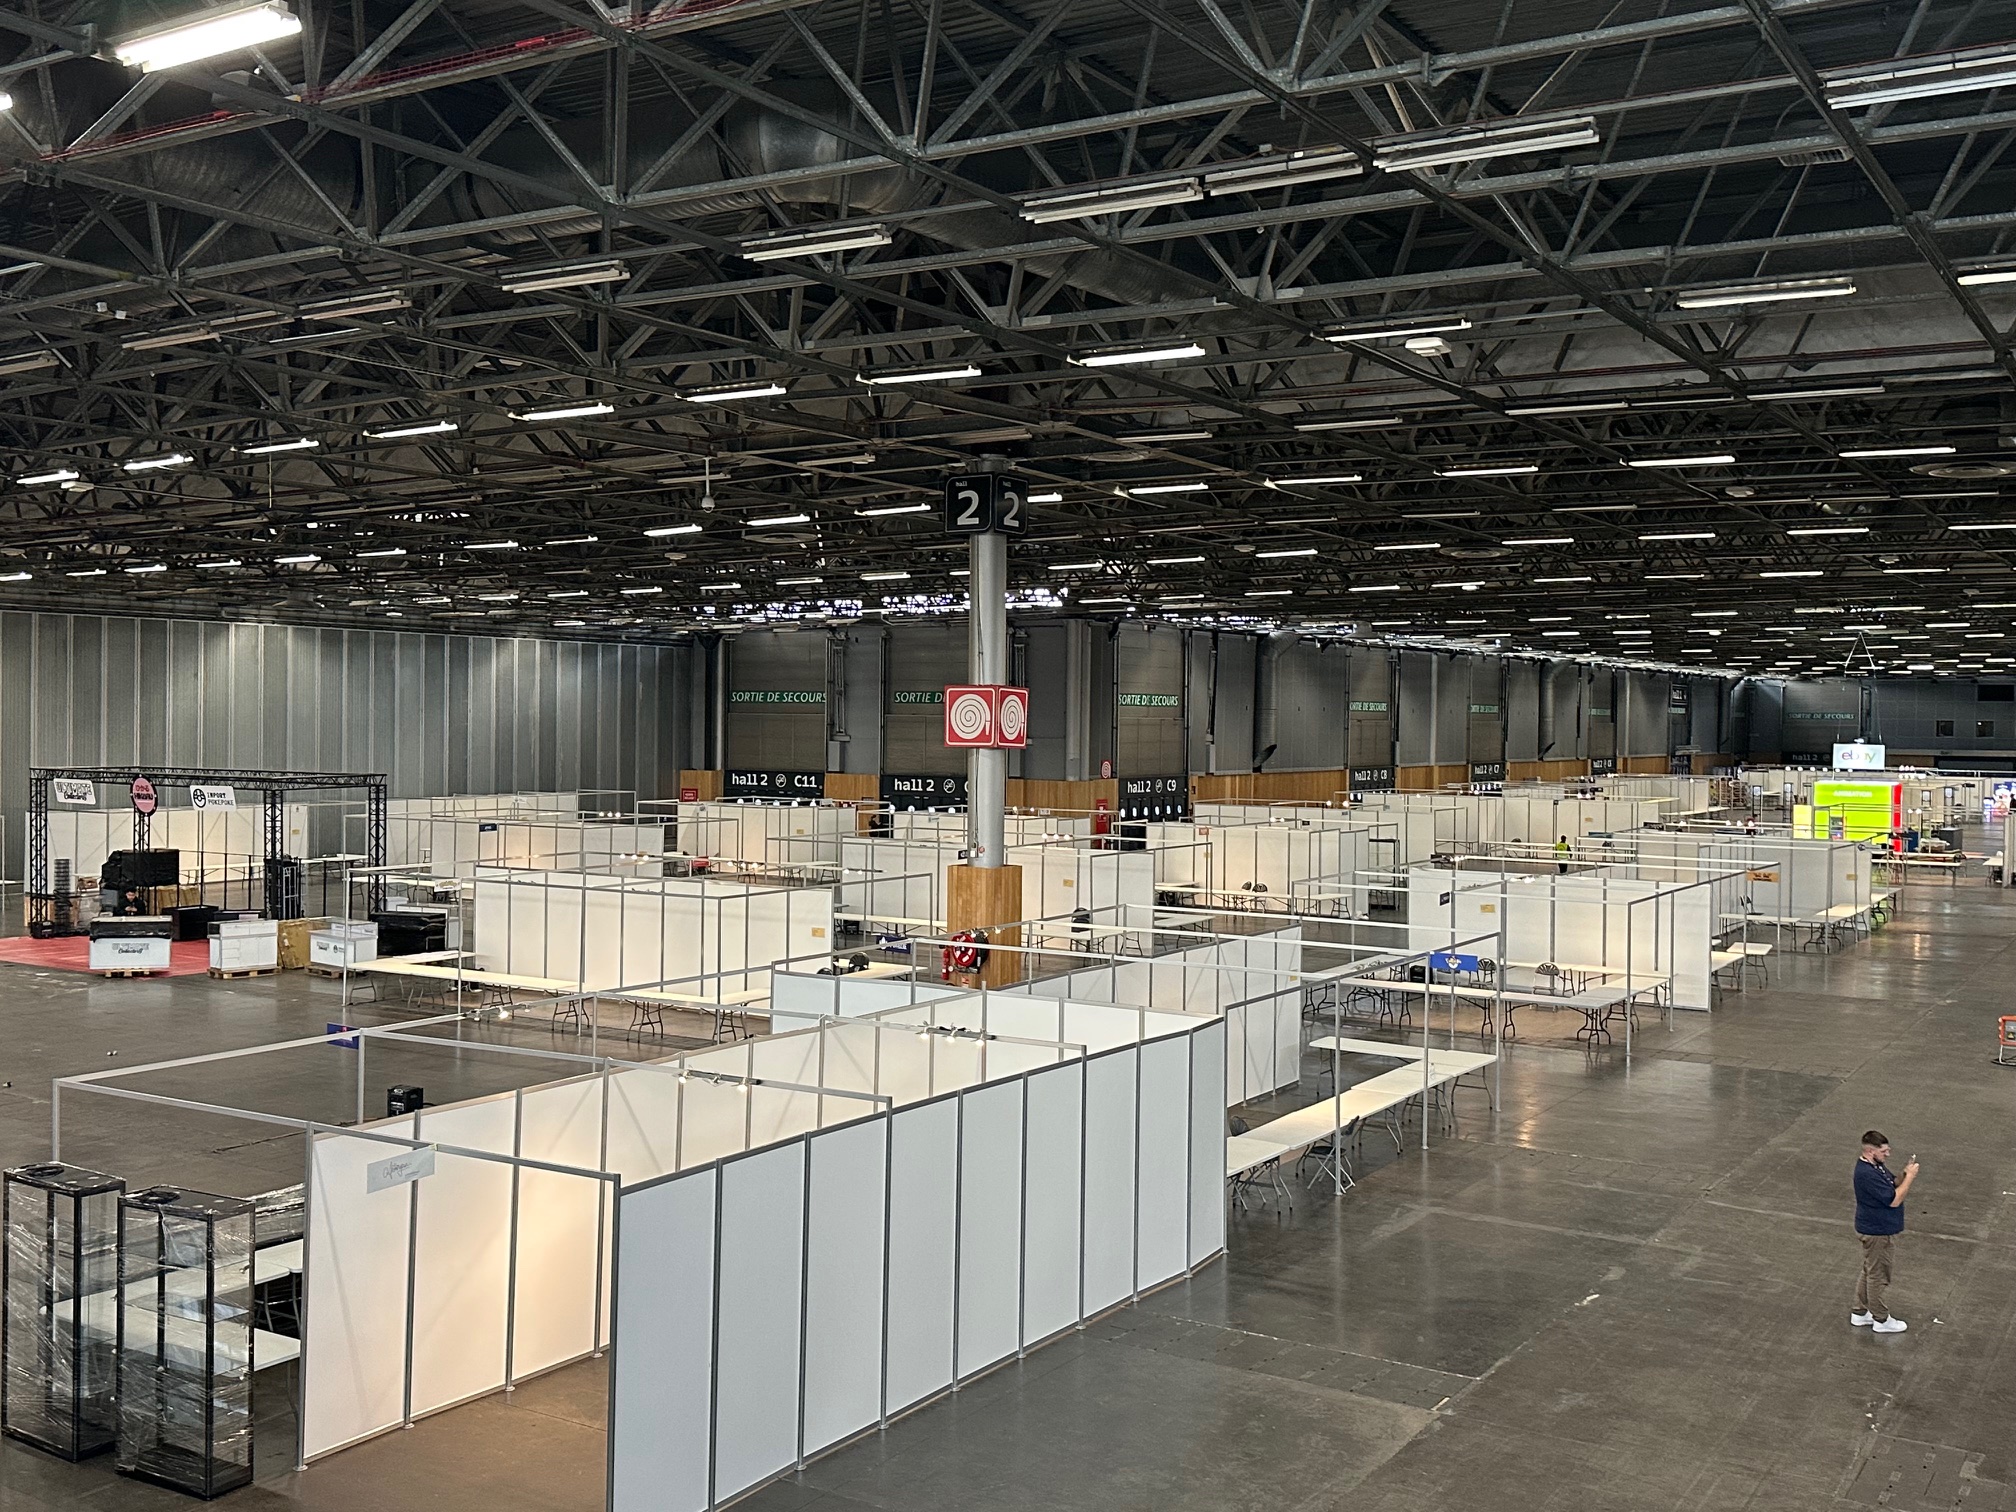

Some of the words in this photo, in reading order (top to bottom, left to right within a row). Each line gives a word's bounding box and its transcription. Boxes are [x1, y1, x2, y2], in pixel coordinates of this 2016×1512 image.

[957, 490, 979, 526] 2
[1003, 491, 1019, 527] 2
[731, 692, 766, 702] SORTIE
[766, 692, 780, 702] DE
[782, 692, 827, 703] SECOURS
[894, 691, 932, 703] SORTIE
[934, 691, 945, 703] D
[1118, 694, 1141, 705] SORTIE
[1151, 695, 1179, 706] SECOURS
[731, 773, 758, 785] hall
[760, 774, 768, 785] 2
[794, 776, 818, 788] C11
[1354, 770, 1367, 781] hall
[894, 779, 923, 791] hall
[926, 780, 935, 791] 2
[1127, 780, 1145, 793] hall
[1145, 780, 1151, 792] 2
[1166, 779, 1177, 791] C9
